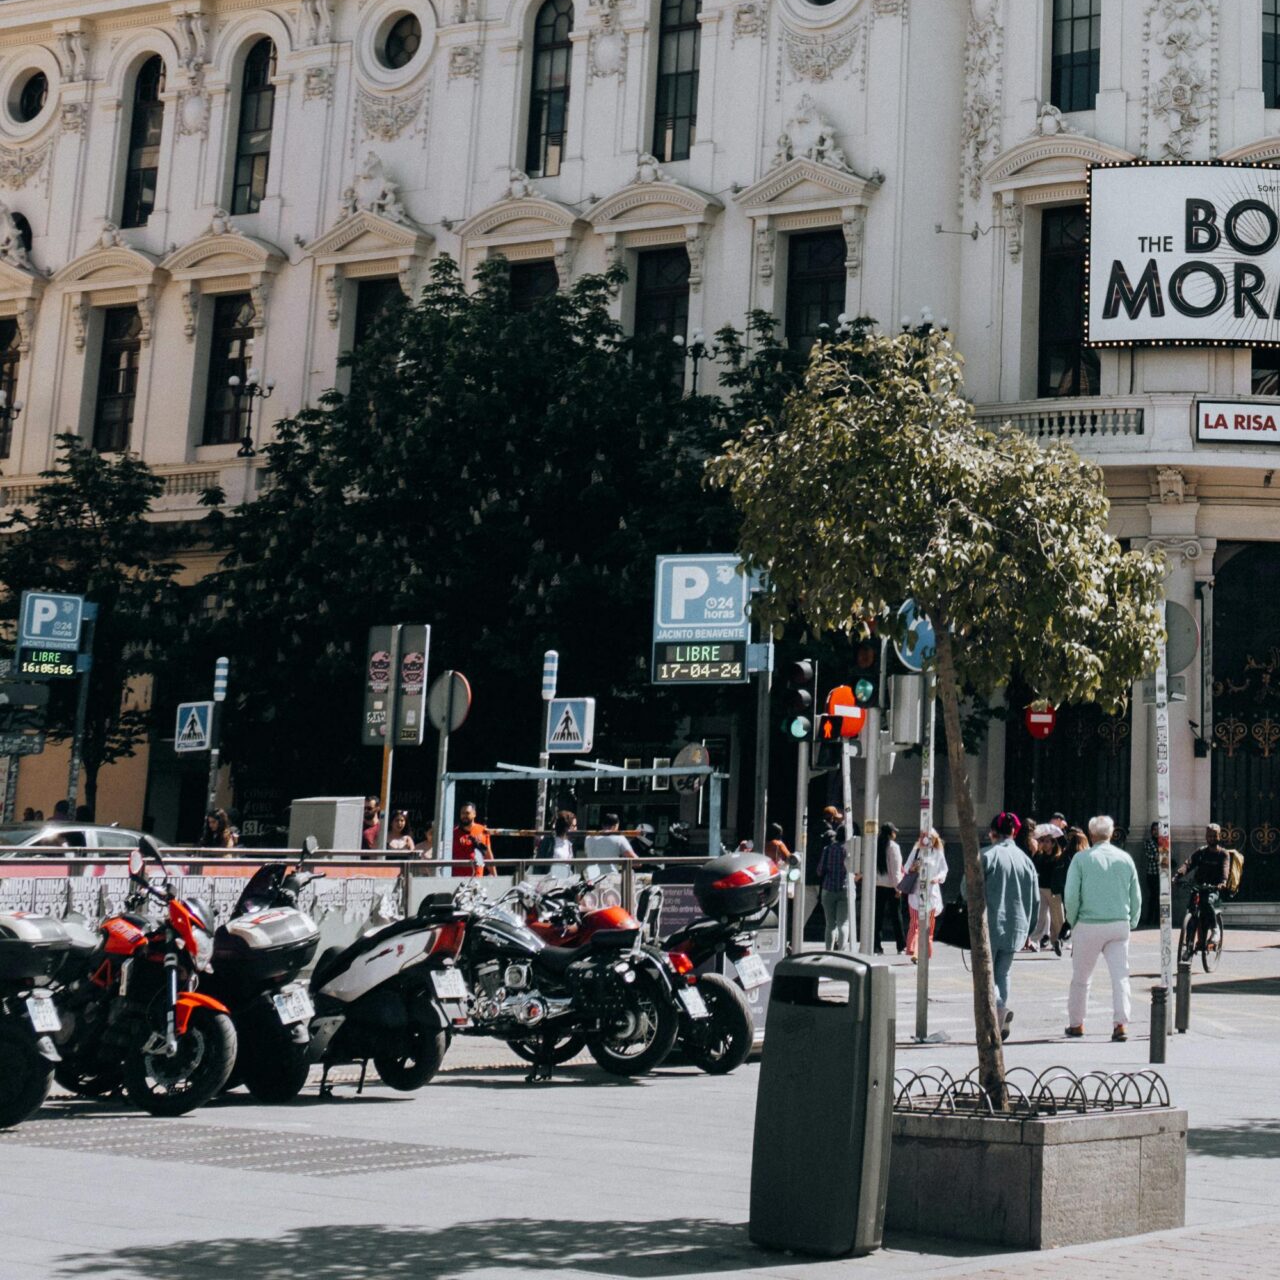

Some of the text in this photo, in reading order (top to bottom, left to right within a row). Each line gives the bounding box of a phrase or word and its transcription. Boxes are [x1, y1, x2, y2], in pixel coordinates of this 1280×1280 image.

[1138, 236, 1173, 253] THE
[1204, 414, 1228, 430] LA
[1234, 414, 1277, 431] RISA
[670, 566, 709, 619] P
[718, 597, 734, 609] 24
[31, 599, 57, 634] P
[704, 608, 735, 619] horas
[60, 622, 72, 630] 24
[656, 628, 745, 639] JACINTO BENAVENTE
[32, 651, 61, 662] LIBRE
[676, 646, 720, 661] LIBRE
[661, 663, 741, 678] 17-04-24
